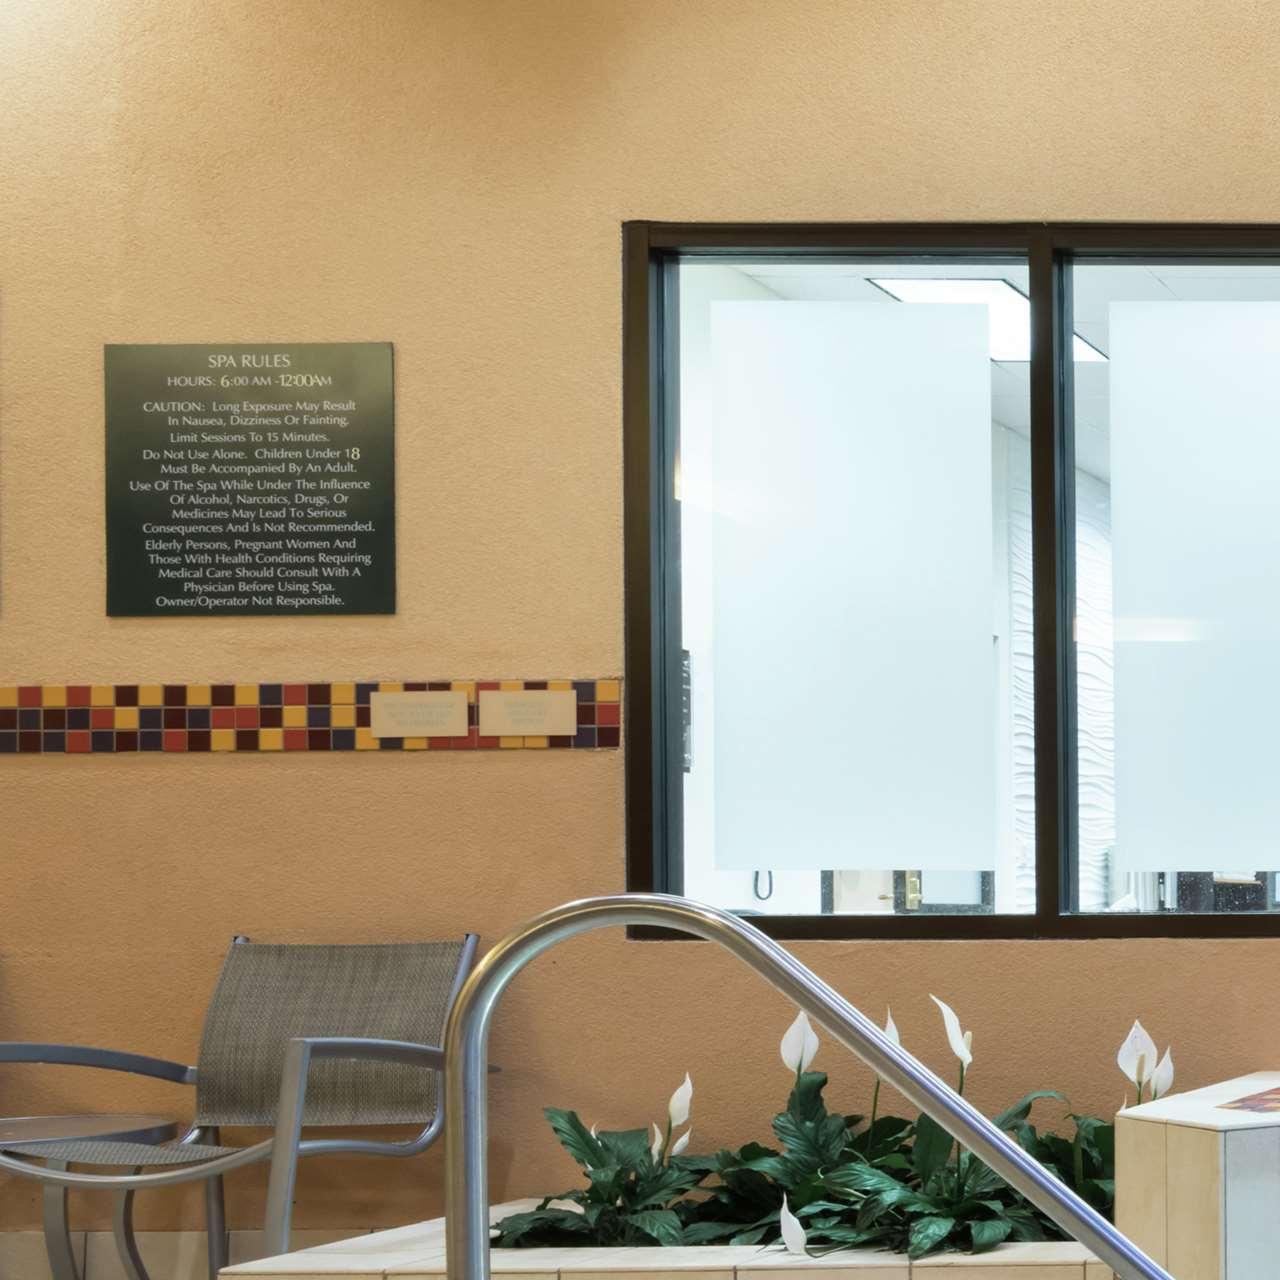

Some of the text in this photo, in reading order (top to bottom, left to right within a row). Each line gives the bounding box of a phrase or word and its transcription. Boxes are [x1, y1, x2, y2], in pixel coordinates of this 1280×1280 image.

[207, 354, 291, 369] SPA RULES
[167, 376, 217, 387] HOURS:
[220, 374, 249, 387] 6:00
[251, 376, 272, 386] AM
[143, 400, 356, 415] CAUTION: Long Exposure May Result
[167, 416, 179, 426] In
[182, 416, 226, 427] Nausea,
[230, 415, 282, 426] Dizziness
[284, 415, 300, 426] Or
[170, 431, 329, 443] Limit Sessions To 15 Minutes.
[143, 447, 361, 460] Do Not Use Alone. Children Under 18
[160, 462, 357, 476] Must Be Accompanied By An Adult.
[129, 478, 371, 493] Use Of The Spa While Under The Influence
[170, 493, 349, 507] Of Alcohol, Narcotics, Drugs, Or
[171, 507, 347, 521] Medicines May Lead To Serious
[142, 521, 375, 536] Consequences And Is Not Recommended.
[145, 538, 356, 553] Elderly Persons, Pregnant Women And
[148, 552, 372, 566] Those With Health Conditions Requiring
[158, 567, 361, 578] Medical Care Should Consult With A
[183, 581, 335, 595] Physician Before Using Spa.
[155, 595, 345, 609] Owner/Operator Not Responsible.
